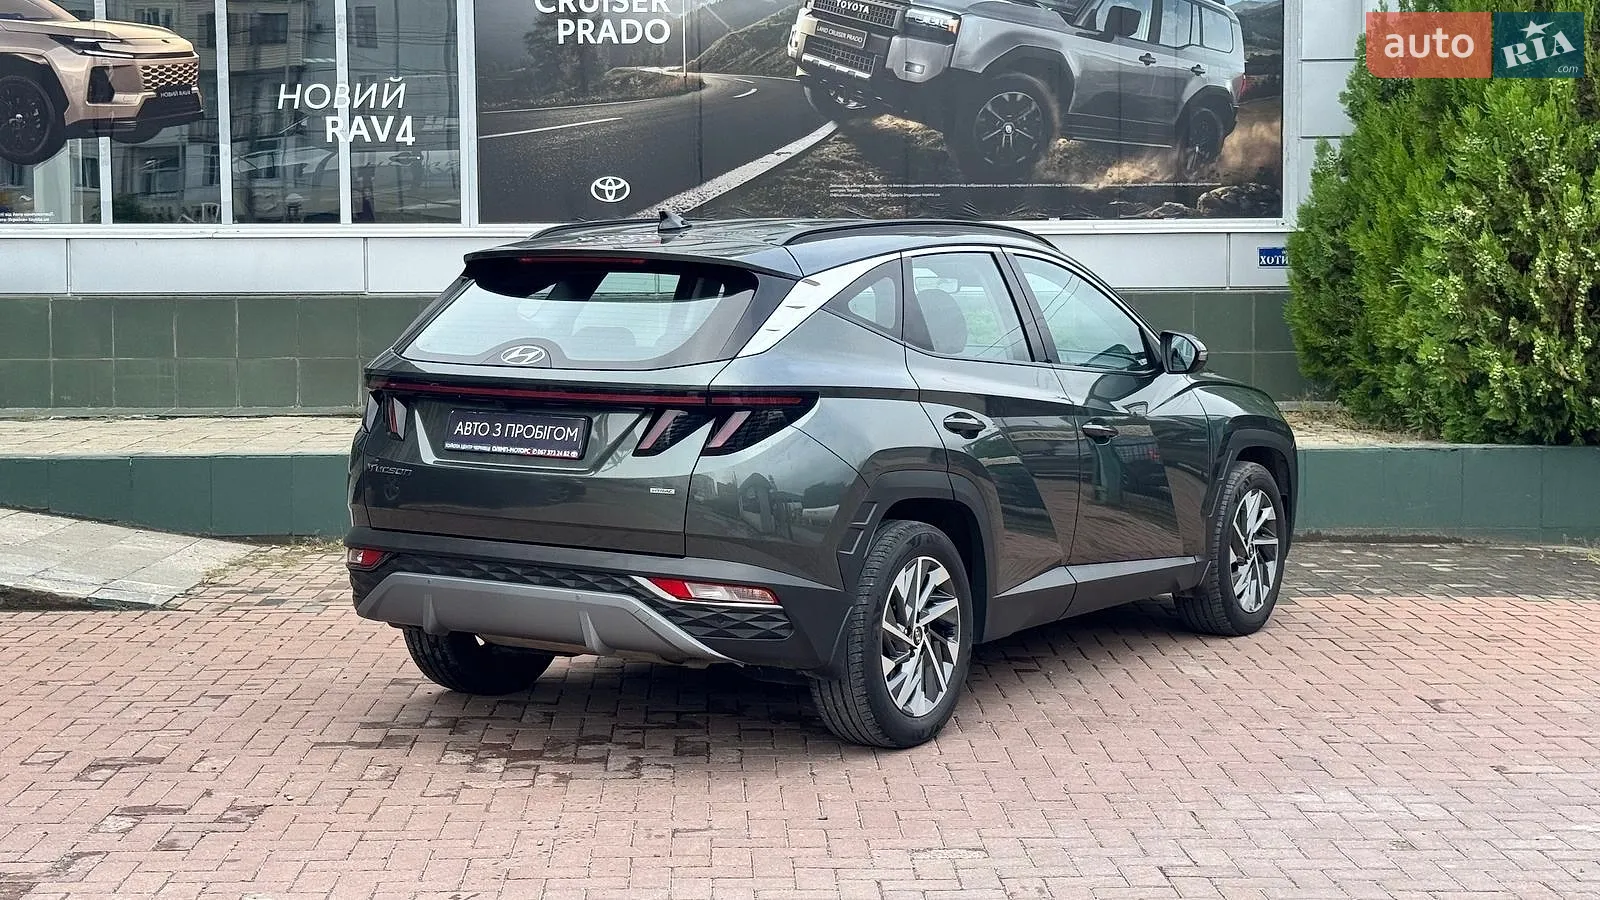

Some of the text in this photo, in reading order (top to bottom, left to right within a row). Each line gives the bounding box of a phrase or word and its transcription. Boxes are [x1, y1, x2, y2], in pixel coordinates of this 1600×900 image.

[836, 0, 869, 14] TOYOTA
[557, 18, 671, 45] PRADO
[816, 25, 863, 43] LAND CRUISER PRADO
[277, 76, 407, 110] НОВИЙ
[325, 115, 416, 146] RAV4
[1259, 255, 1289, 265] ХОТИ
[453, 421, 490, 437] АВТО
[504, 424, 579, 442] ПРОБІГОМ
